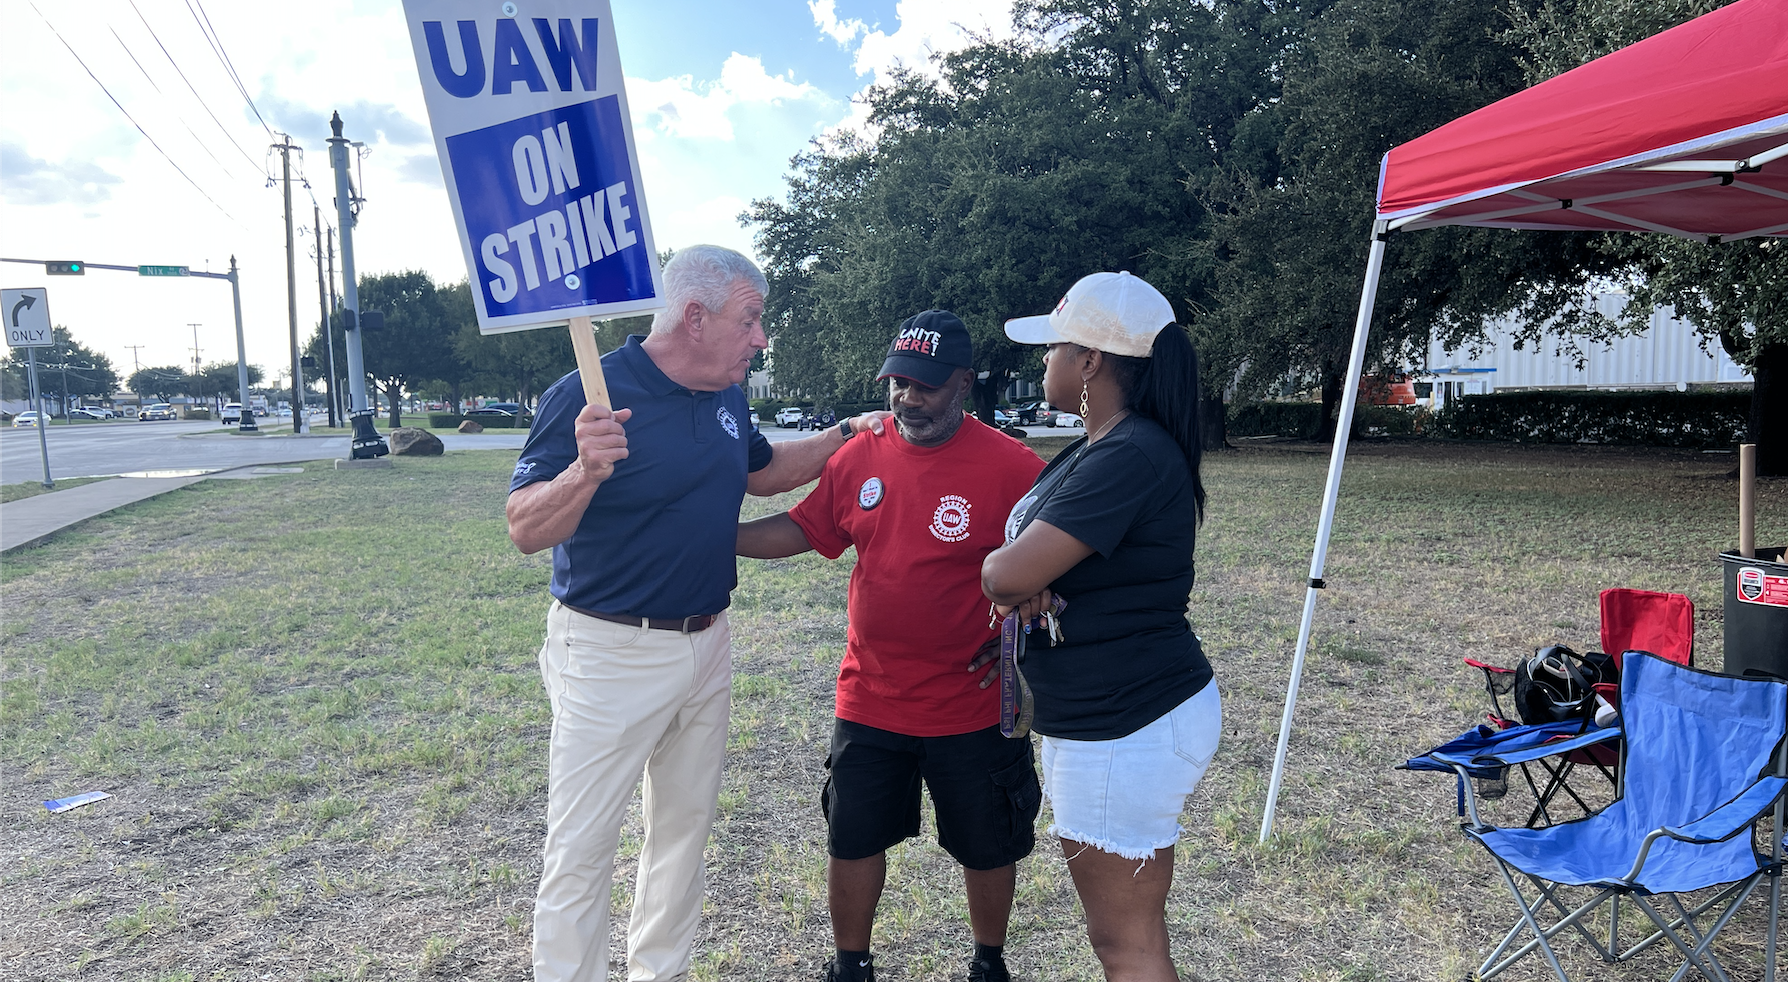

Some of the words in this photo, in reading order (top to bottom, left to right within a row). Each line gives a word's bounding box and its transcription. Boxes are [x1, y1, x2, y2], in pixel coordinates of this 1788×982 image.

[422, 18, 599, 99] UAW
[512, 121, 580, 206] ON
[481, 181, 637, 304] STRIKE
[147, 266, 164, 276] Nix
[12, 329, 44, 342] ONLY
[899, 327, 942, 346] UNITE
[894, 338, 938, 357] HERE!
[940, 494, 968, 505] REGION
[942, 512, 961, 525] UAW
[955, 531, 971, 542] CLUB
